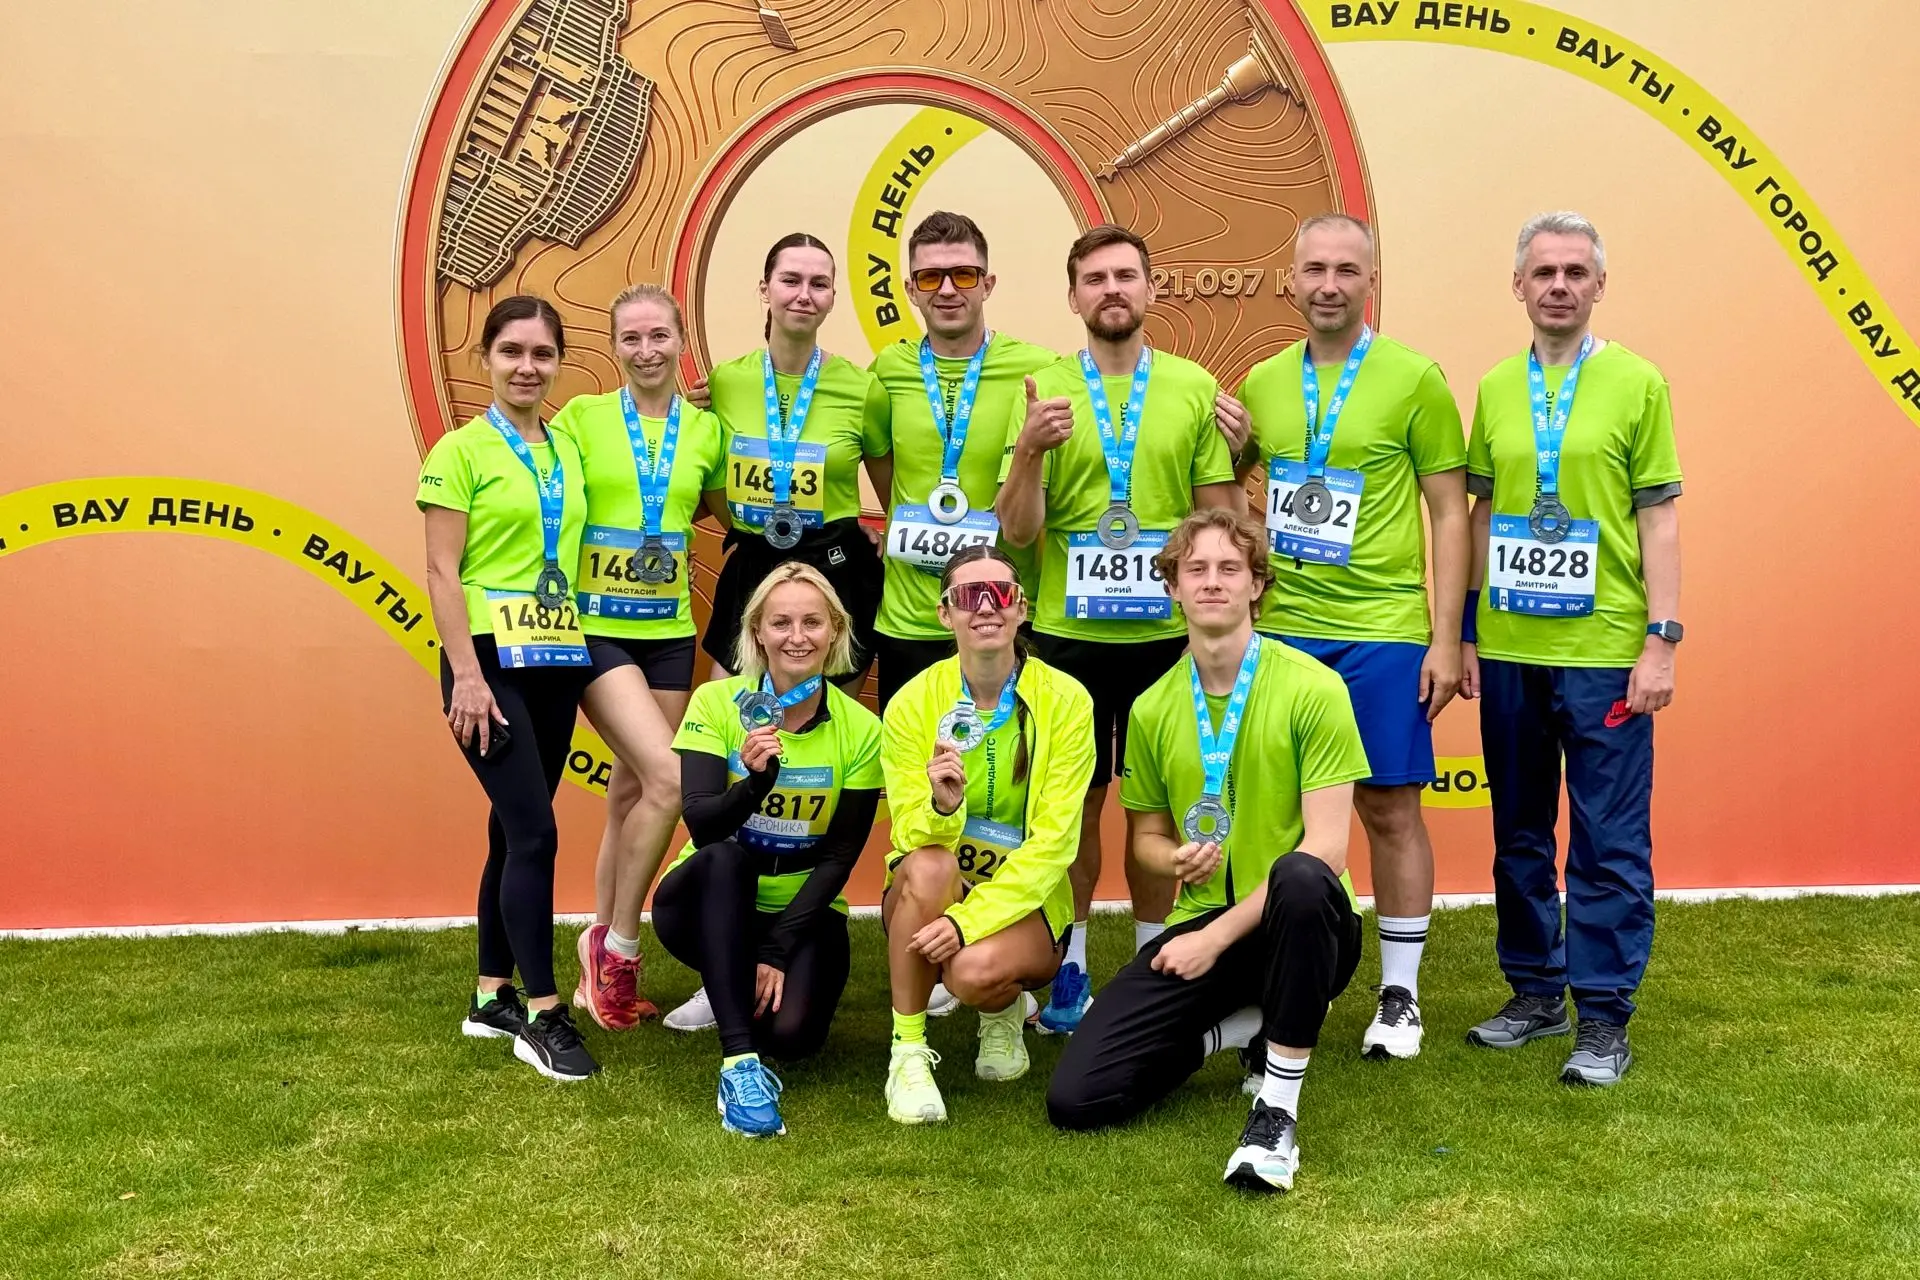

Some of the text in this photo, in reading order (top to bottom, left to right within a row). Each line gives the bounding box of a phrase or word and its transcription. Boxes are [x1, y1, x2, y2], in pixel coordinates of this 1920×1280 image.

[1331, 1, 1399, 28] ВАУ
[1414, 1, 1511, 34] ДЕНЬ
[1555, 27, 1625, 69] ВАУ
[1628, 59, 1675, 105] ТЫ
[1696, 115, 1758, 170] ВАУ
[1755, 176, 1839, 282] ГОРОД
[1847, 300, 1901, 358] ВАУ
[867, 145, 935, 327] ВАУ ДЕНЬ
[1150, 267, 1265, 302] 21,097
[1004, 445, 1016, 455] МТ
[746, 495, 796, 507] АНАСТЯ
[1272, 487, 1352, 529] 142
[1283, 523, 1320, 535] АЛЕКСЕЙ
[52, 497, 423, 632] ВАУ ДЕНЬ ВАУ ТЫ
[1496, 544, 1589, 579] 14828
[605, 586, 657, 596] АНАСТАСИЯ
[1105, 586, 1132, 594] ЮРИЙ
[1515, 580, 1558, 590] ДМИТРИЙ
[499, 603, 579, 631] 14822
[764, 793, 827, 822] 817
